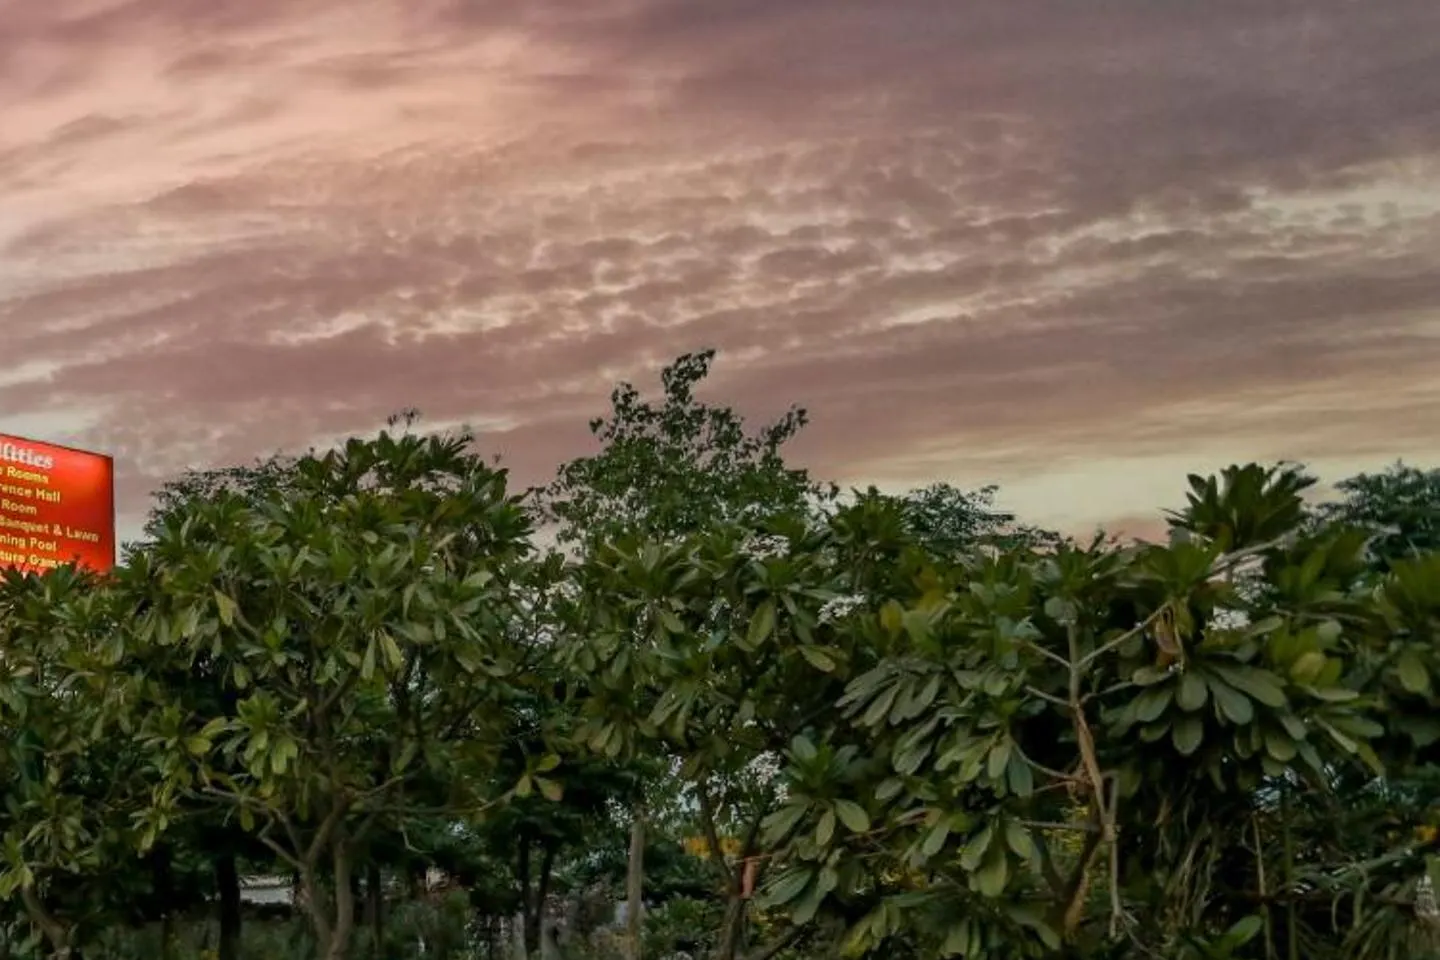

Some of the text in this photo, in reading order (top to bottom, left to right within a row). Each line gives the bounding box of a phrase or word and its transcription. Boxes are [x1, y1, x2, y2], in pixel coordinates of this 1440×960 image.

[7, 466, 49, 484] Rooms
[36, 487, 61, 504] Hall
[1, 498, 37, 516] Room
[53, 523, 63, 537] &
[66, 526, 99, 542] Lawn
[30, 537, 57, 552] Pool
